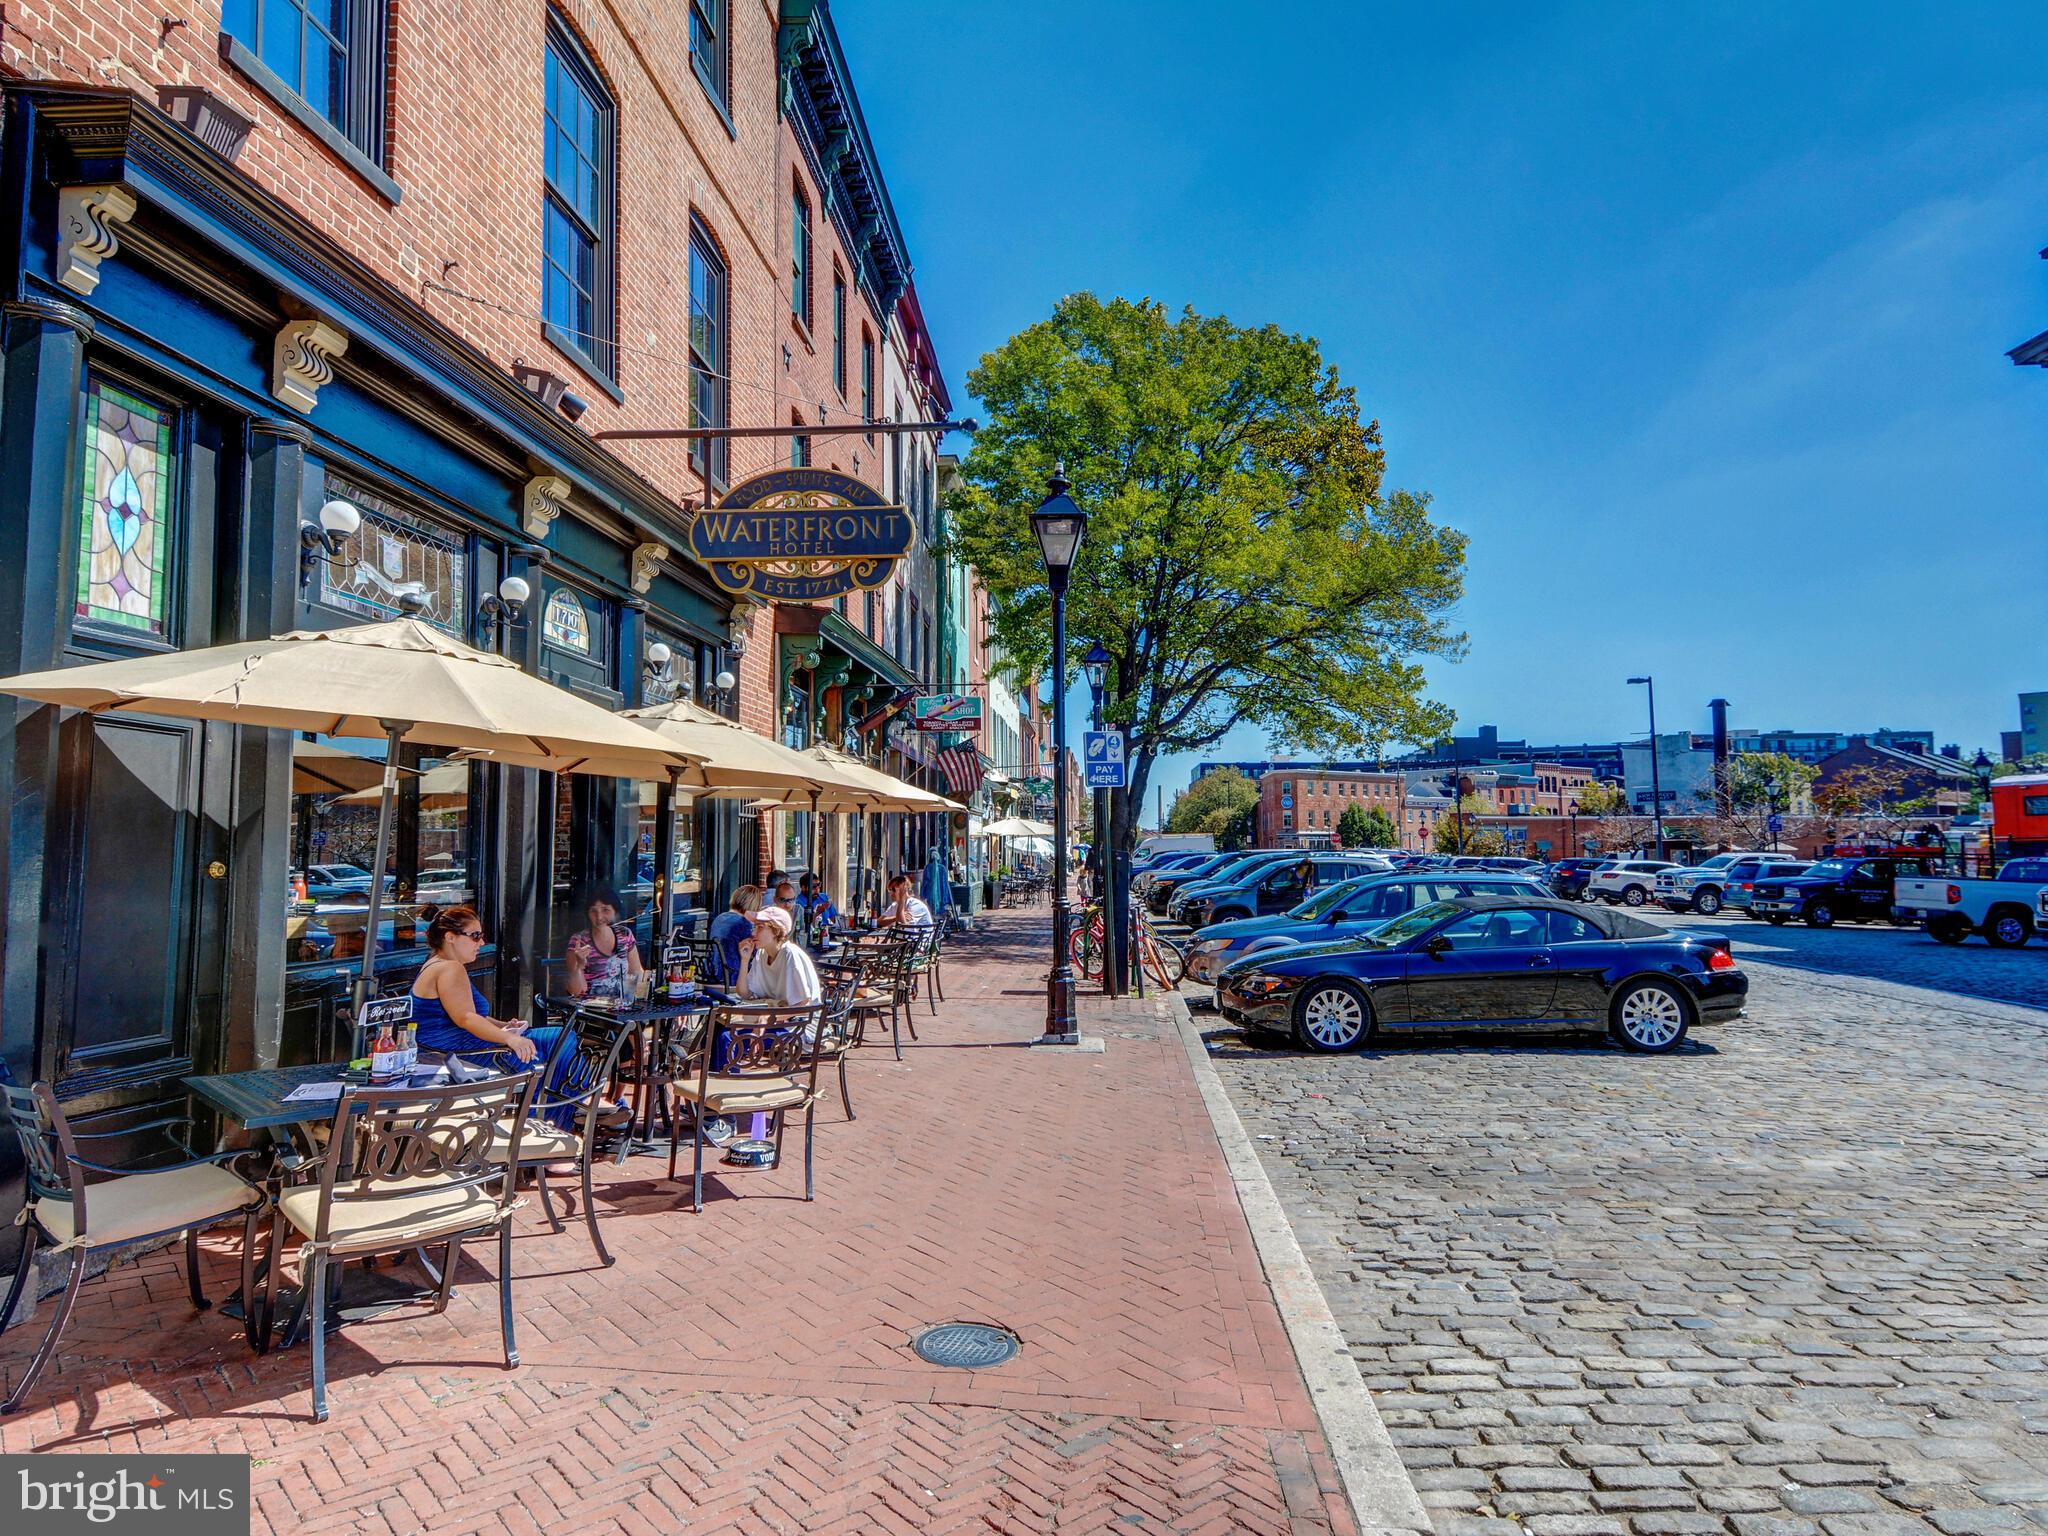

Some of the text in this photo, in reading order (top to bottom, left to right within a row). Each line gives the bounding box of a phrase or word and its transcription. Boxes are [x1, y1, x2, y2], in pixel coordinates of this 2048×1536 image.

[734, 479, 772, 505] FOOD
[785, 471, 833, 487] SPIRITS
[702, 513, 900, 543] WATERFRONT
[769, 541, 835, 555] HOTEL
[764, 579, 799, 596] EST.
[555, 607, 578, 628] 1710
[955, 706, 976, 715] SHOP
[1110, 736, 1118, 745] 4
[1095, 765, 1114, 774] PAY
[1093, 775, 1119, 783] HERE
